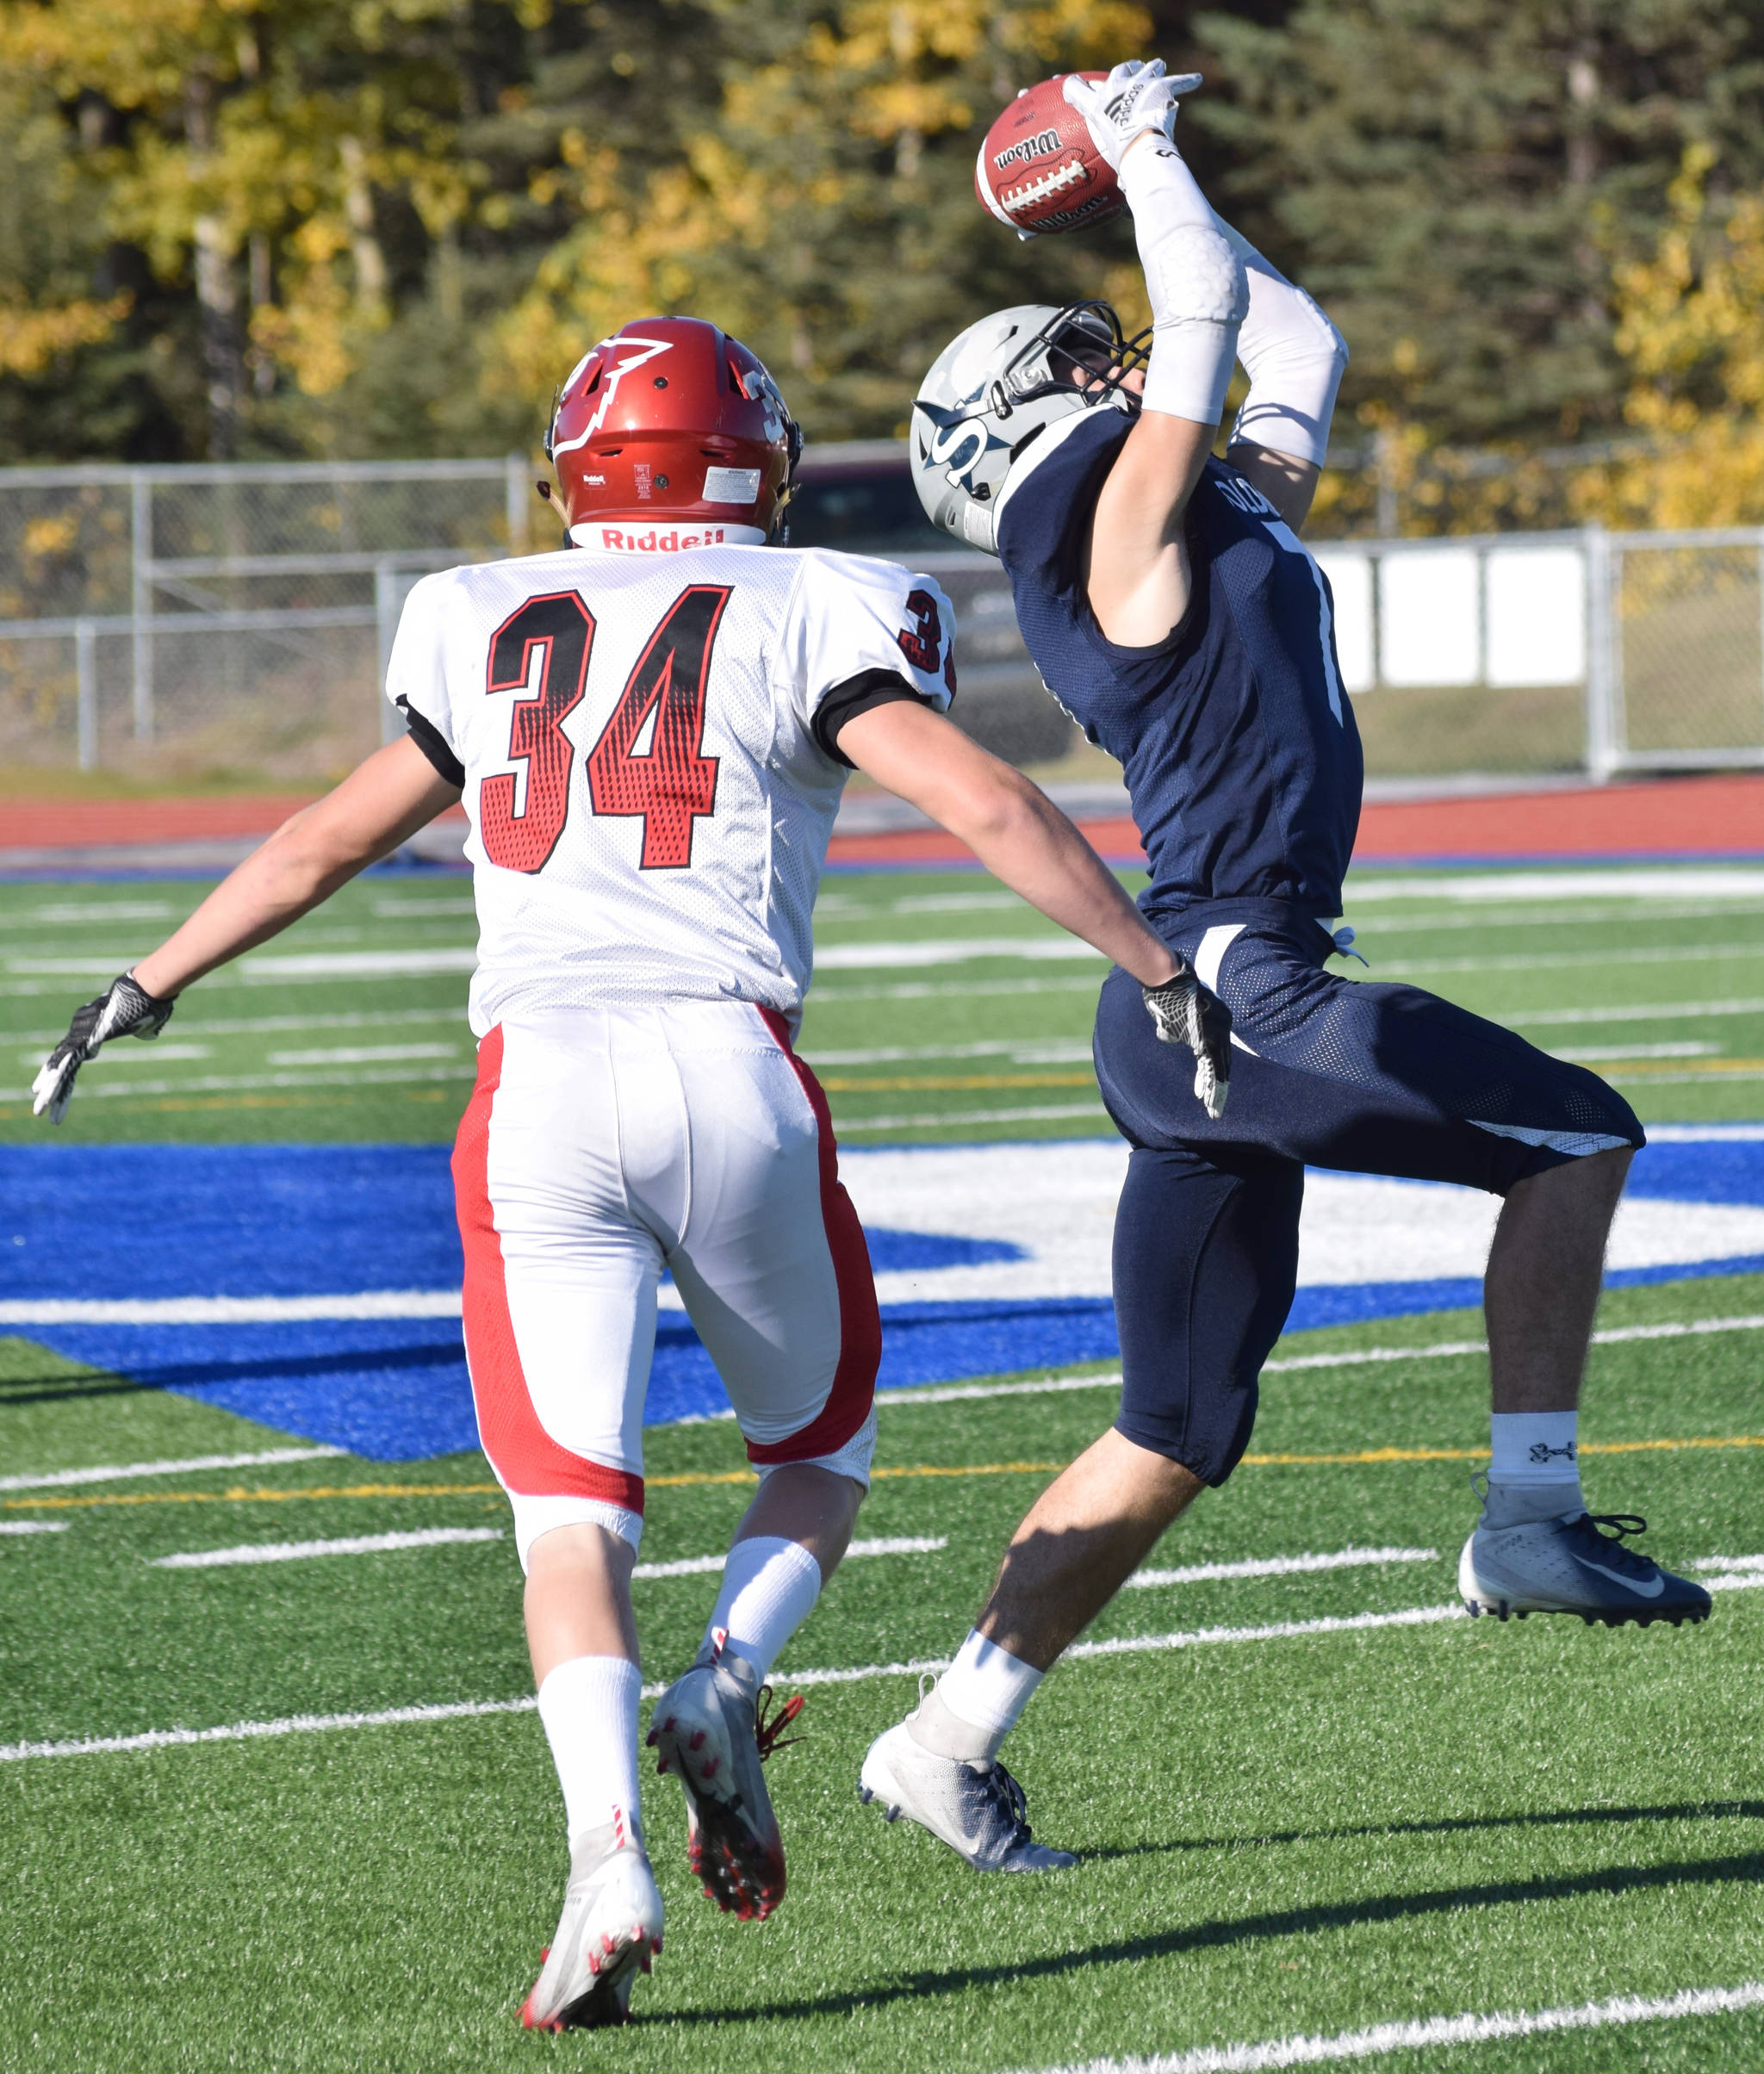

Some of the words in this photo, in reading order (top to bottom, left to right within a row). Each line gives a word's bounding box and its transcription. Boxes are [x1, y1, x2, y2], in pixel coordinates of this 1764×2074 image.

[994, 128, 1063, 170] Wilson
[602, 529, 724, 551] Riddell
[480, 583, 735, 875] 34
